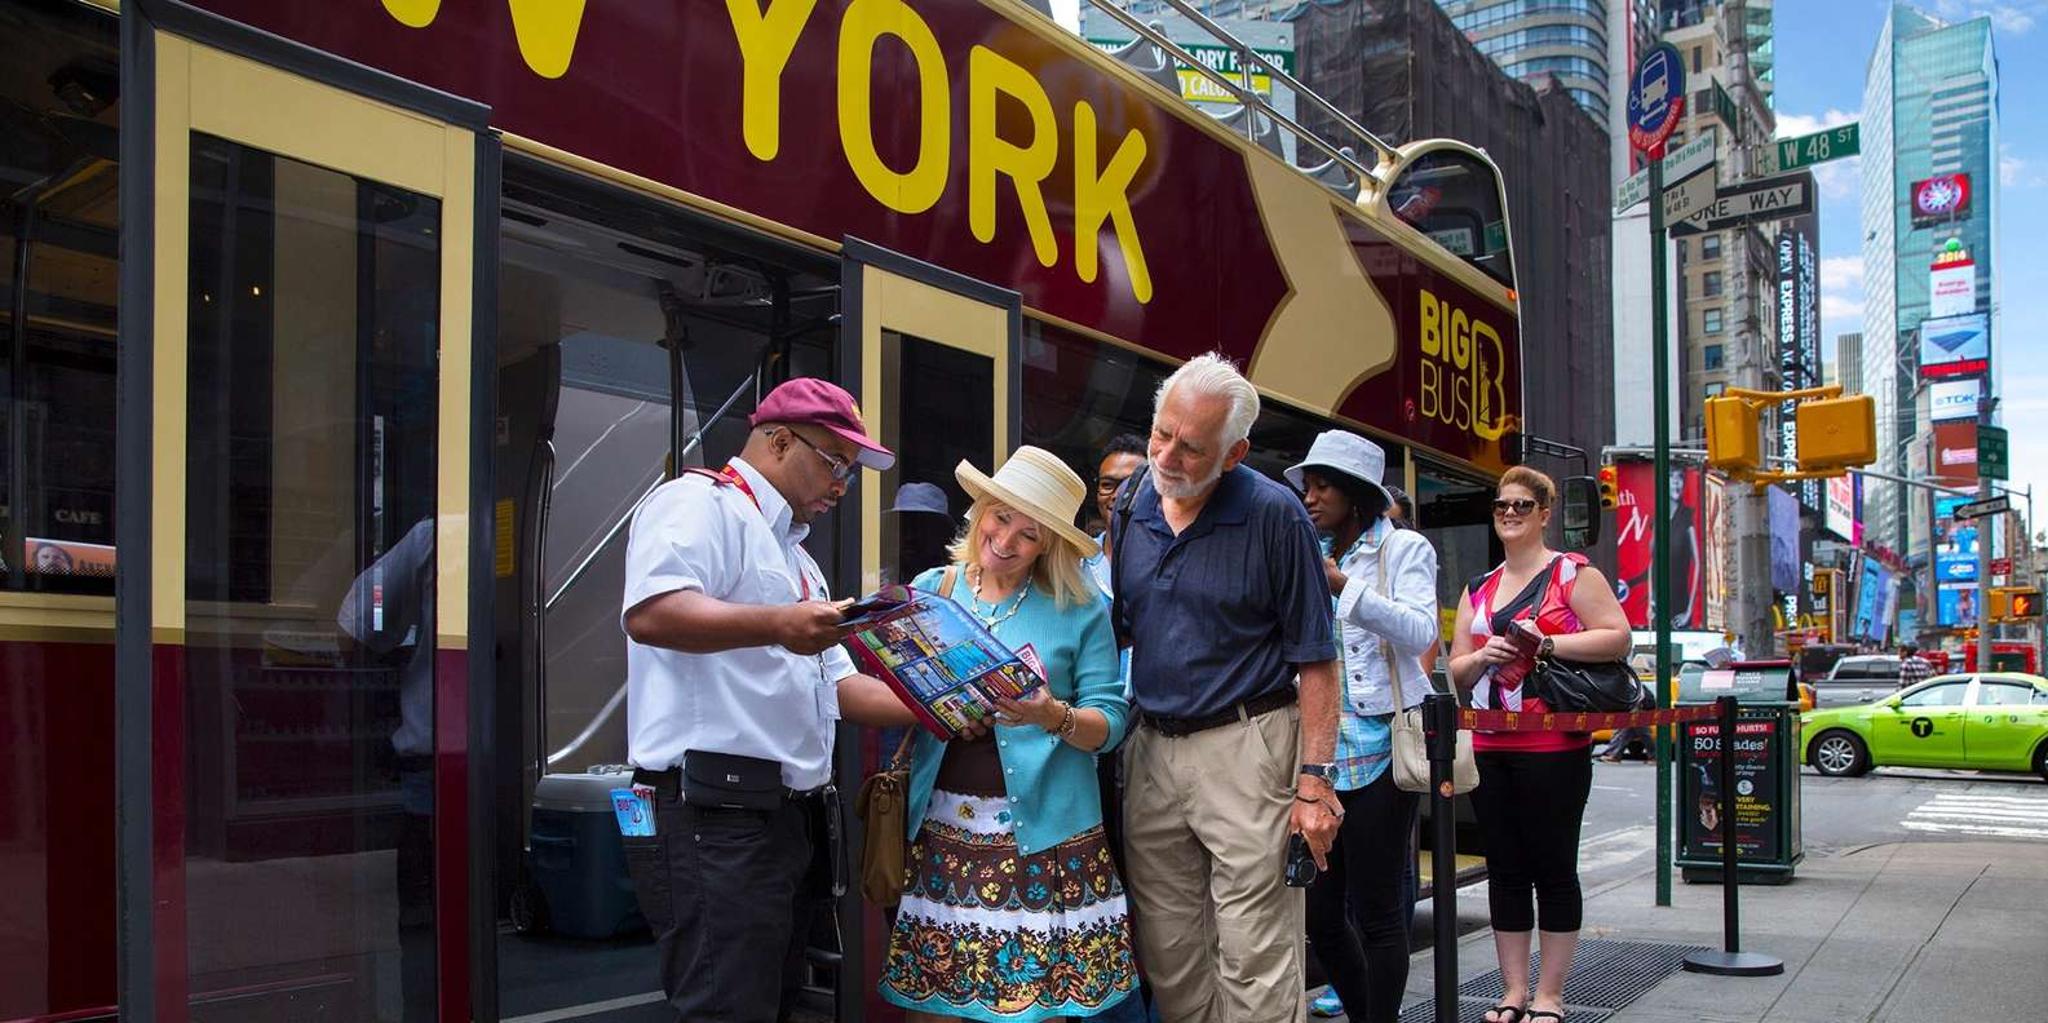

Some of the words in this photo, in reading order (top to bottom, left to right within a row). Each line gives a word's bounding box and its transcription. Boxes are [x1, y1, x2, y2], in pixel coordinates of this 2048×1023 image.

[724, 0, 1152, 303] YORK
[1783, 141, 1799, 166] W
[1806, 134, 1830, 160] 48
[1837, 127, 1854, 143] ST
[1690, 199, 1730, 221] ONE
[1749, 187, 1793, 211] WAY
[1420, 289, 1470, 370] BIG
[1781, 280, 1794, 344] EXPRESS
[1420, 358, 1470, 431] BUS
[1946, 393, 1975, 405] TDK
[55, 509, 102, 525] CAFE
[1694, 737, 1713, 750] 50
[1695, 726, 1706, 735] SO
[1736, 724, 1768, 734] HURTS!
